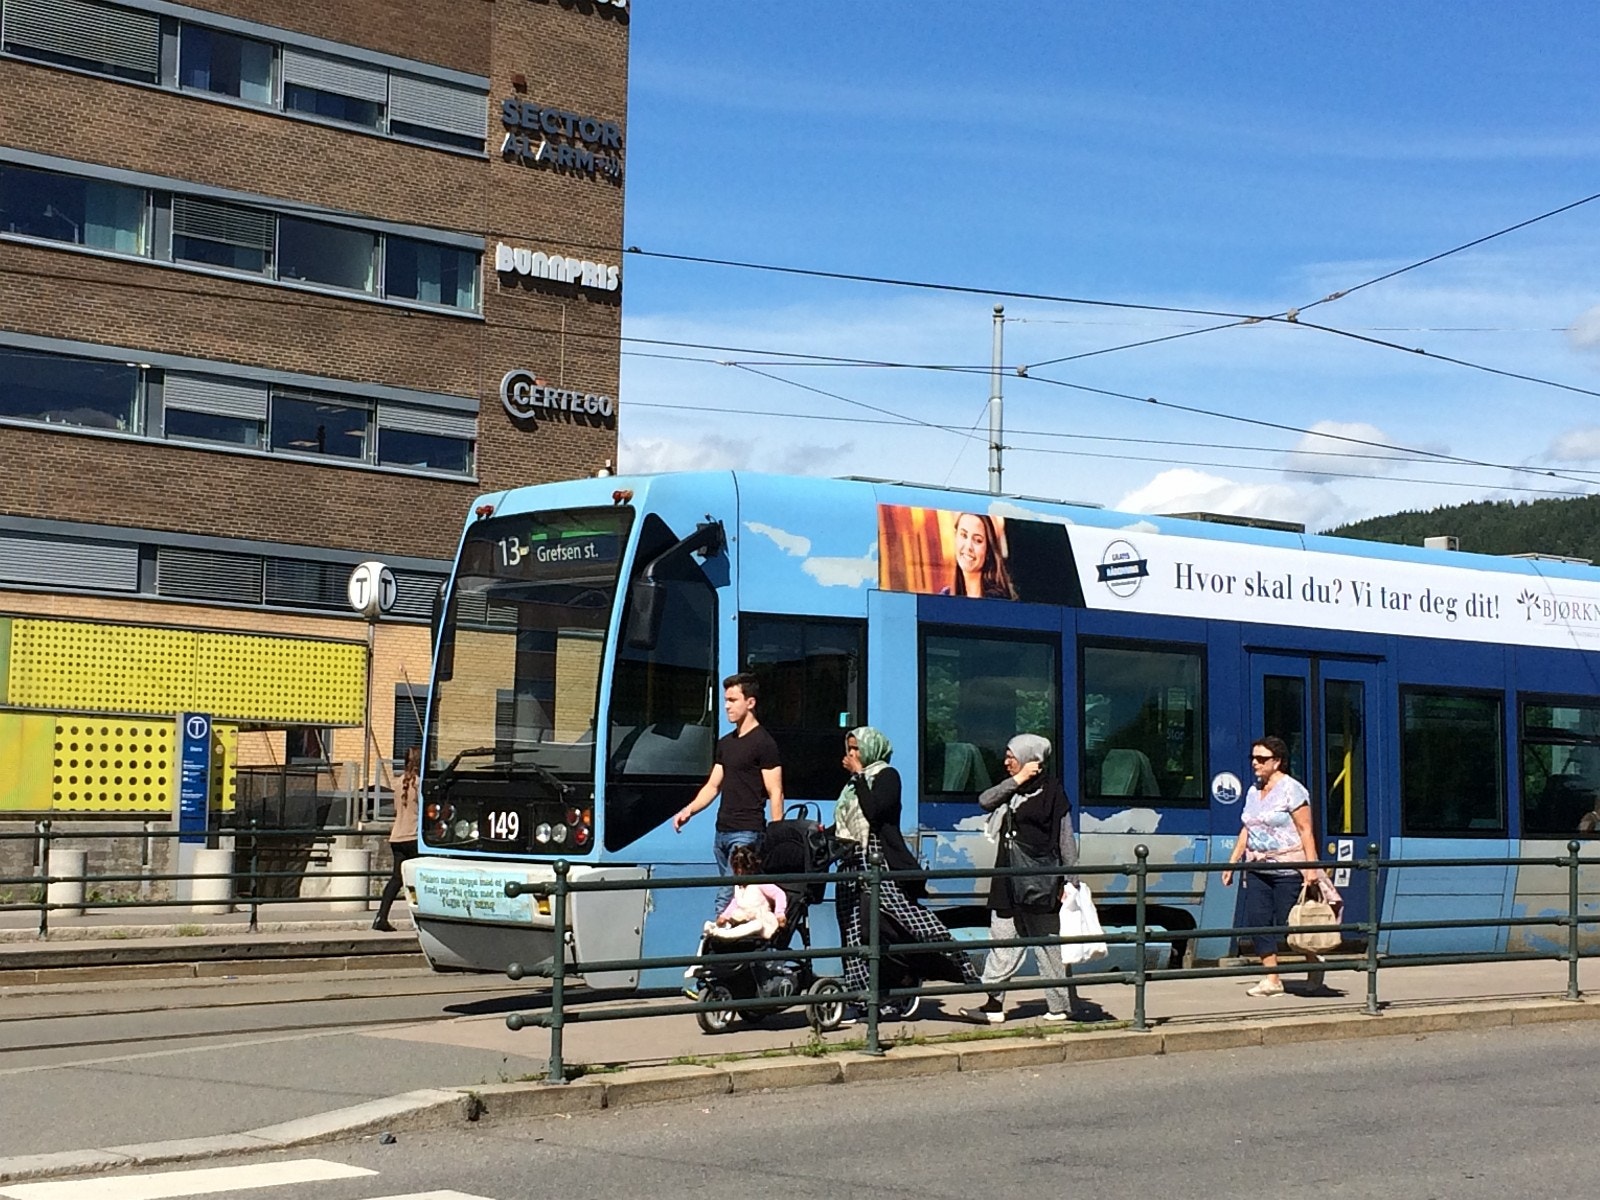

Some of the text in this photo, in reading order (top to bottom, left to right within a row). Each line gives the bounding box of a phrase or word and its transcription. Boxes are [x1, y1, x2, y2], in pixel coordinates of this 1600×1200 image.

[502, 99, 621, 148] SECTOR
[500, 132, 595, 172] ALARM
[496, 241, 620, 292] BUNNPRIS
[513, 380, 613, 418] CERTEGO
[498, 536, 521, 567] 13
[1173, 561, 1237, 595] Hvor
[1244, 570, 1293, 600] skal
[1302, 576, 1343, 605] du?
[1350, 580, 1373, 608] Vi
[1380, 586, 1412, 611] tar
[1419, 588, 1459, 623] deg
[1465, 592, 1500, 619] dit!
[488, 811, 519, 840] 149
